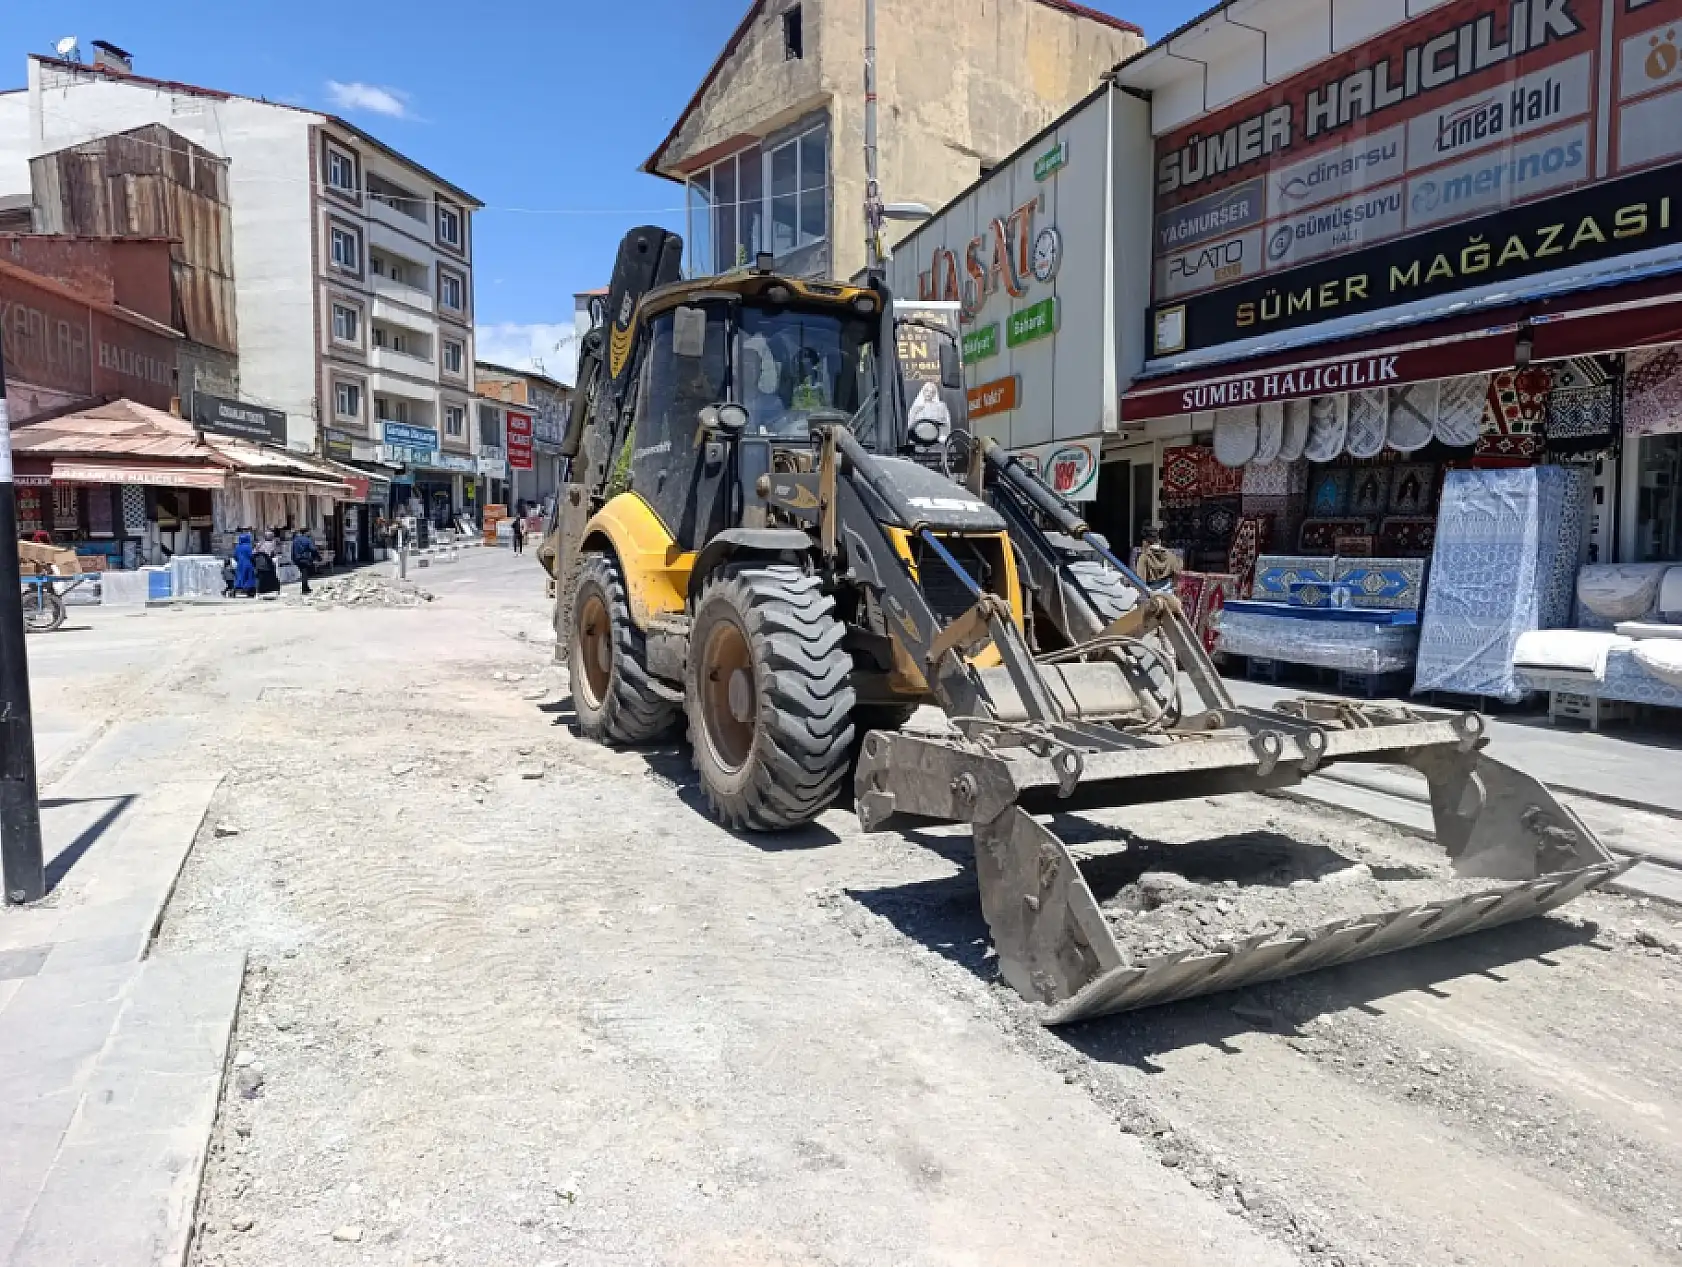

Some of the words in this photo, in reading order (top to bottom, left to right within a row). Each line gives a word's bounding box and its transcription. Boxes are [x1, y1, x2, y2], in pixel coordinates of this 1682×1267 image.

[1158, 104, 1292, 197] SÜMER
[1306, 0, 1581, 140] HALICILIK
[1437, 102, 1504, 152] Linea
[1510, 77, 1561, 128] Halı
[1307, 141, 1397, 187] dinarsu
[1443, 139, 1583, 204] merinos
[1160, 200, 1249, 246] YAĞMURŞER
[1295, 194, 1401, 239] GÜMÜŞSUYU
[1169, 239, 1243, 280] PLATO
[1236, 274, 1368, 328] SÜMER
[1389, 196, 1670, 292] MAĞAZASI
[1262, 355, 1400, 397] HALICILIK
